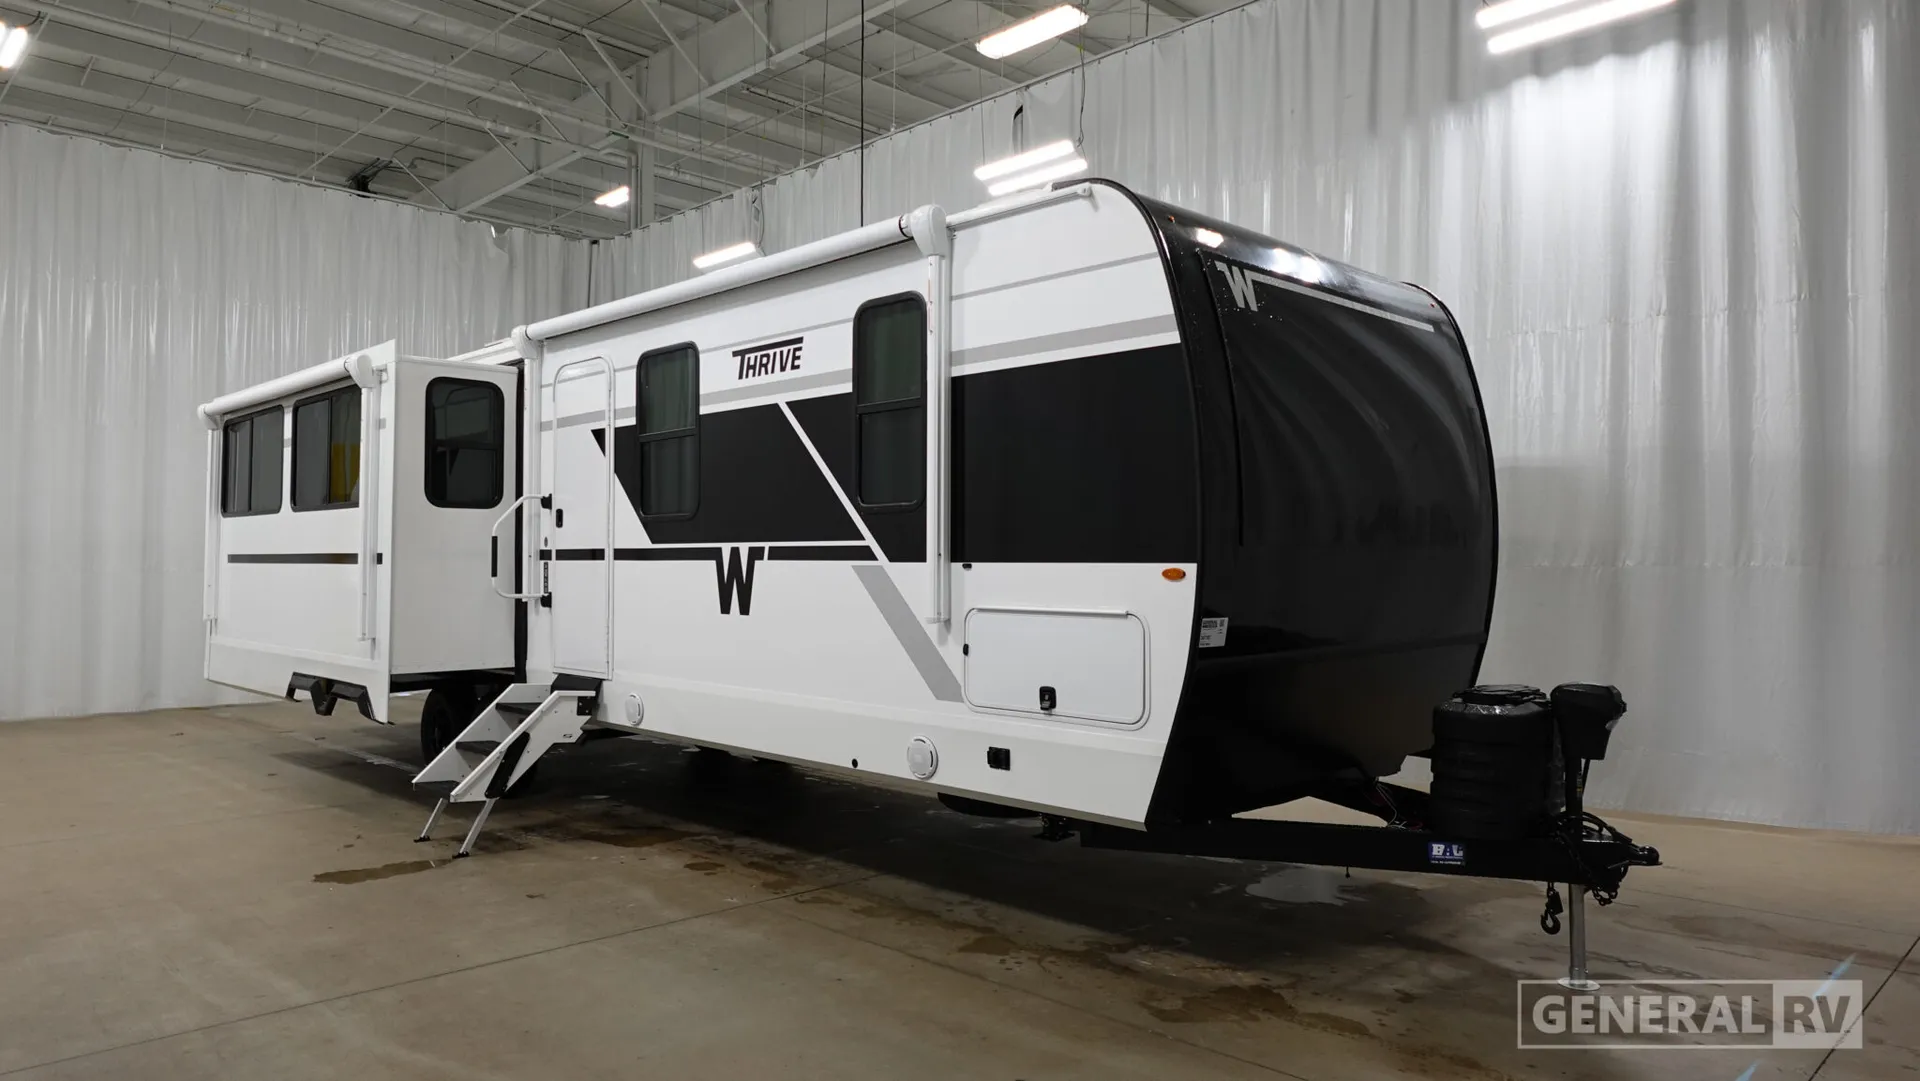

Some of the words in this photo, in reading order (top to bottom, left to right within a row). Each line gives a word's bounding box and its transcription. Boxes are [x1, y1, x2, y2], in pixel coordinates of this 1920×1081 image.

[1213, 260, 1258, 312] W
[732, 336, 804, 380] THRIVE
[715, 546, 764, 616] W
